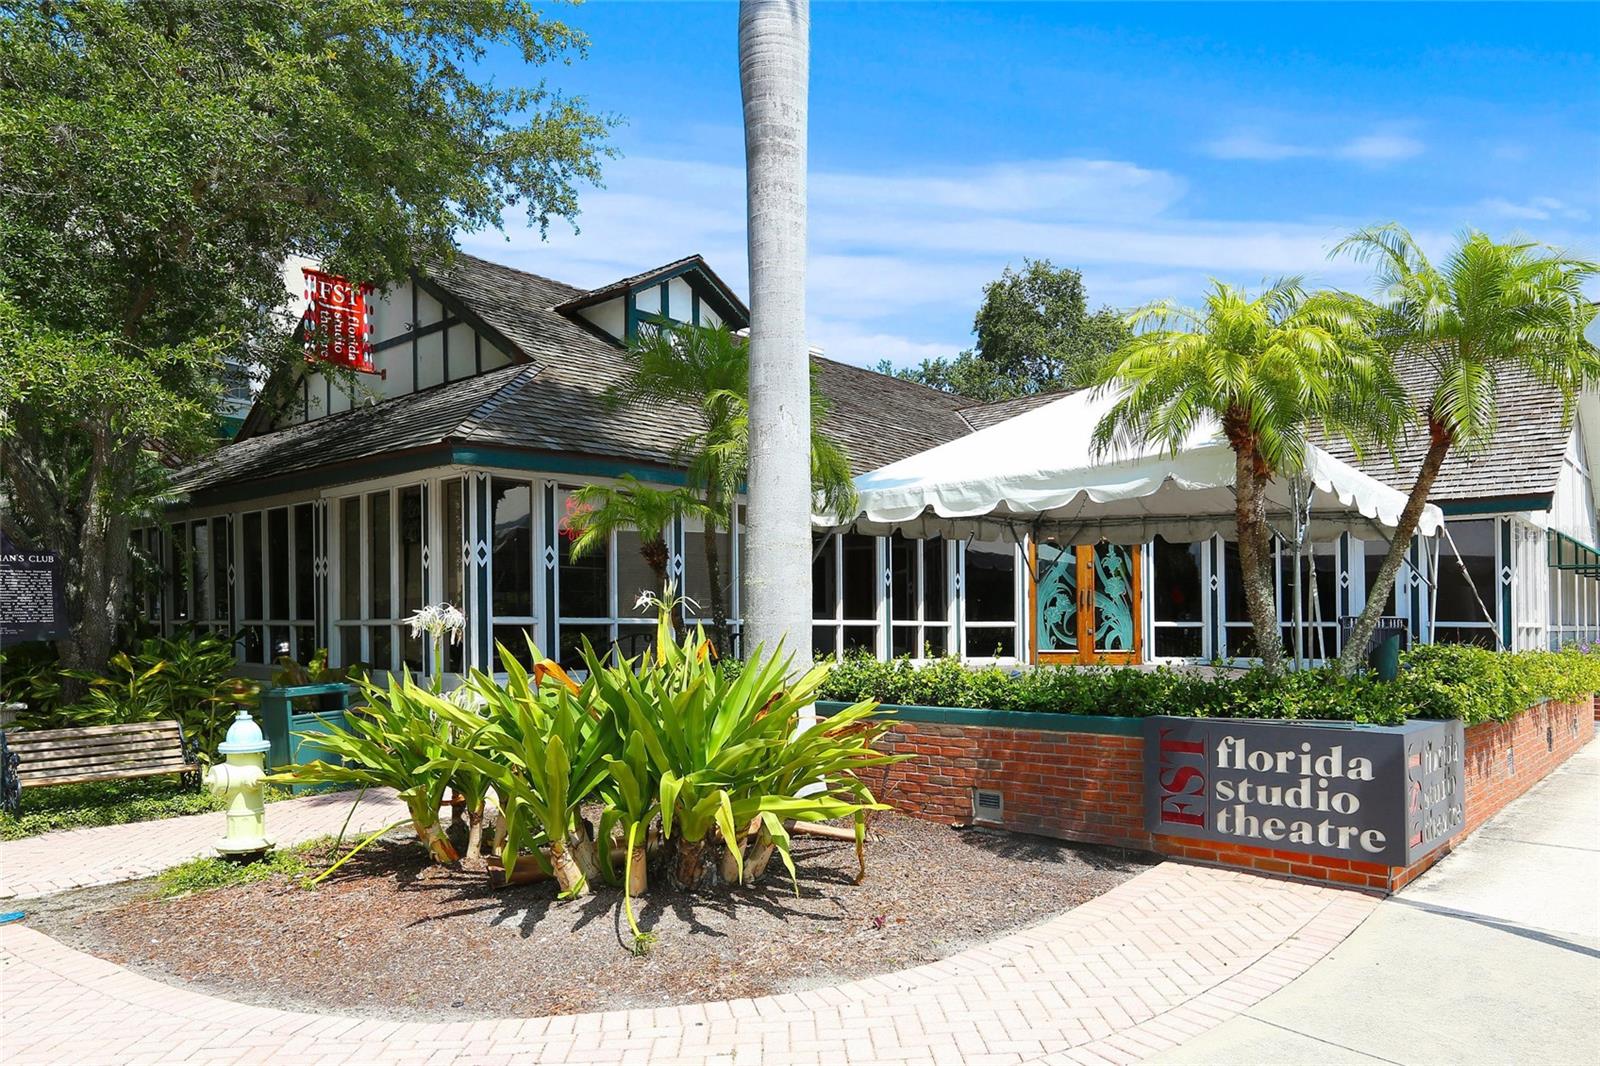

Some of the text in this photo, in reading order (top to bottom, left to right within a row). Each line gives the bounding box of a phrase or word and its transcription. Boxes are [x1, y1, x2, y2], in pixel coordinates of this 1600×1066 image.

[319, 280, 361, 307] FST
[320, 310, 332, 358] there
[347, 315, 360, 361] florida
[0, 553, 55, 563] AN'S CLUB
[1158, 727, 1206, 830] FST
[1215, 735, 1375, 782] florida
[1215, 776, 1361, 815] studio
[1216, 803, 1387, 854] theatre
